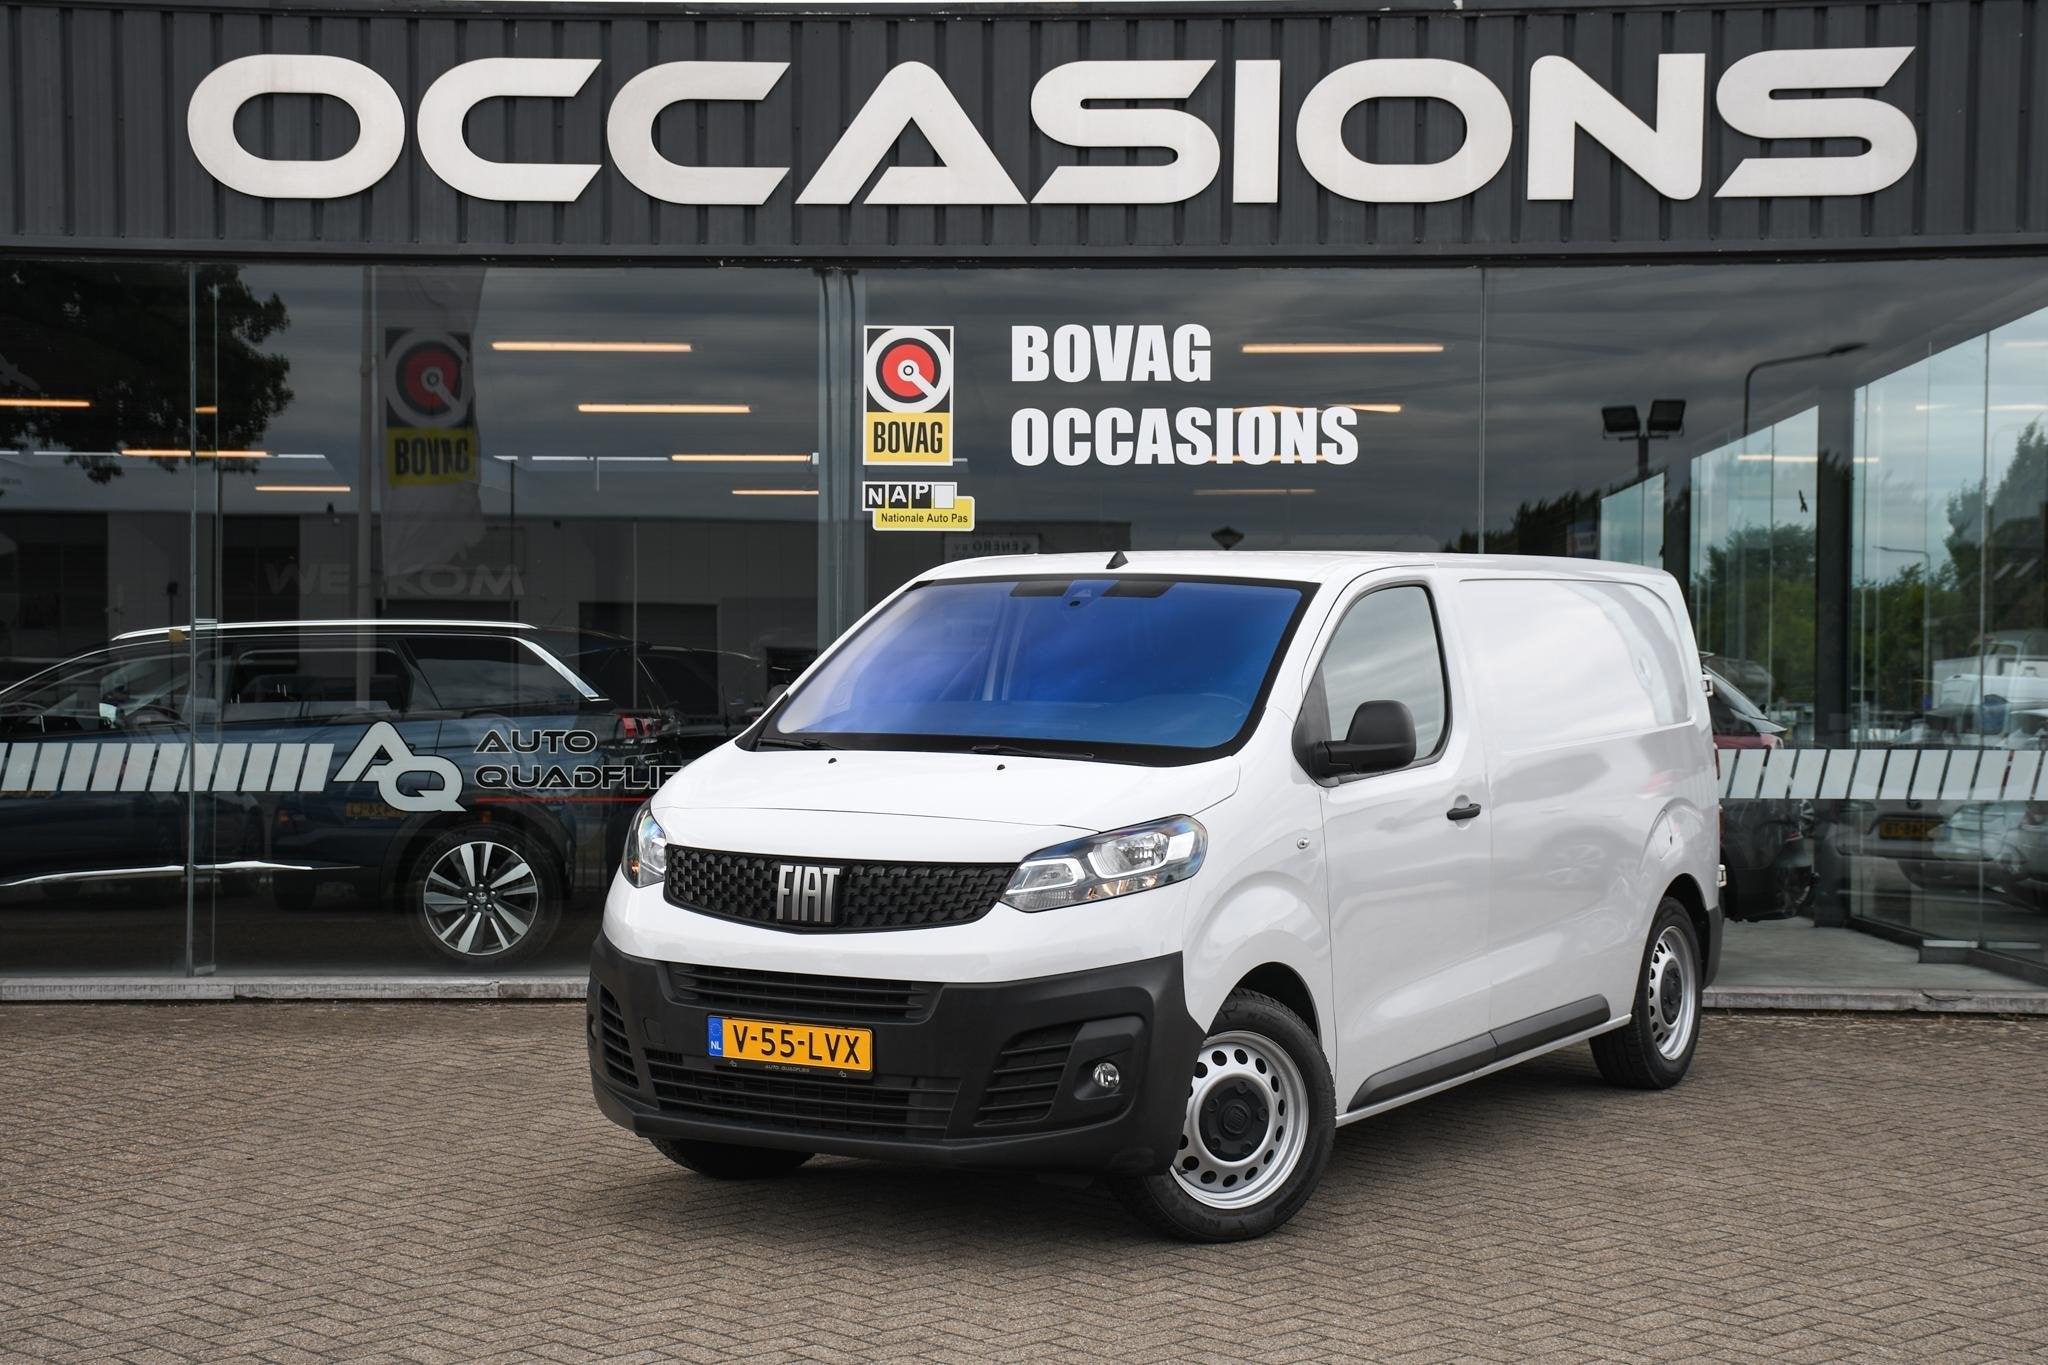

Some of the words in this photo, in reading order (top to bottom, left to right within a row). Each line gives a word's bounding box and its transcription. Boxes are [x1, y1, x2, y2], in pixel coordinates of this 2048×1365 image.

[187, 46, 1917, 204] OCCASIONS
[1010, 323, 1212, 383] BOVAG
[873, 421, 943, 454] BOVAG
[1010, 406, 1359, 466] OCCASIONS
[868, 485, 930, 506] NAP
[881, 513, 924, 523] Nationale
[927, 513, 949, 523] Auto
[951, 514, 968, 523] Pas
[263, 563, 525, 597] WEKOM
[474, 730, 598, 754] AUTO
[333, 720, 468, 813] AQ
[777, 864, 840, 923] FIAT
[710, 1040, 722, 1051] NL
[733, 1025, 860, 1064] V-55-LVX
